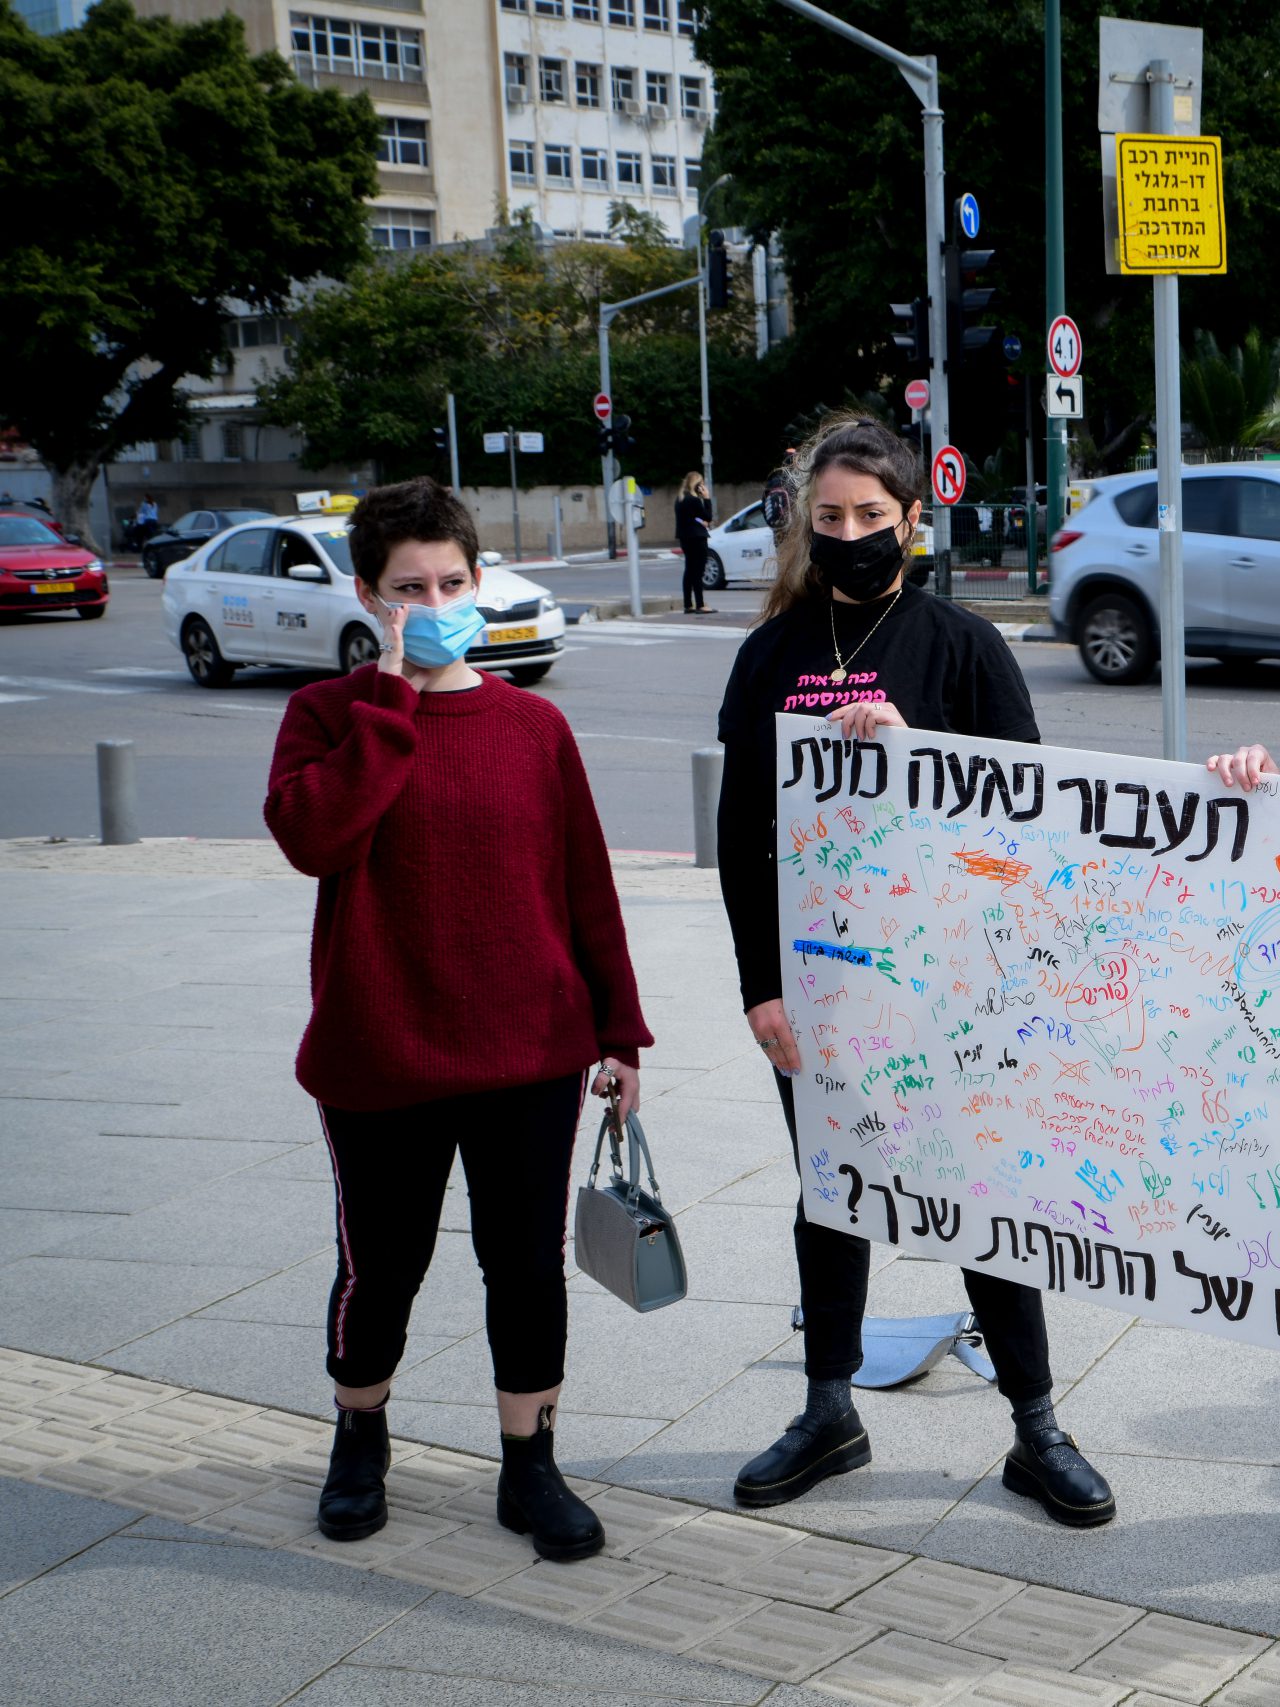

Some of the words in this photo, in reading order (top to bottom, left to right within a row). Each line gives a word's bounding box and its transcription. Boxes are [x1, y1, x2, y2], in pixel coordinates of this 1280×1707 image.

[1128, 149, 1158, 164] רכב
[1165, 150, 1210, 166] חניית
[1135, 170, 1205, 188] דו-גלגלי
[1143, 198, 1200, 212] ברחבת
[1139, 221, 1205, 236] המדרכה
[1147, 244, 1200, 258] אסורה
[1055, 337, 1073, 360] 4.1
[782, 736, 888, 803] מינית
[1057, 778, 1249, 862] תעבור
[1173, 1250, 1254, 1322] של
